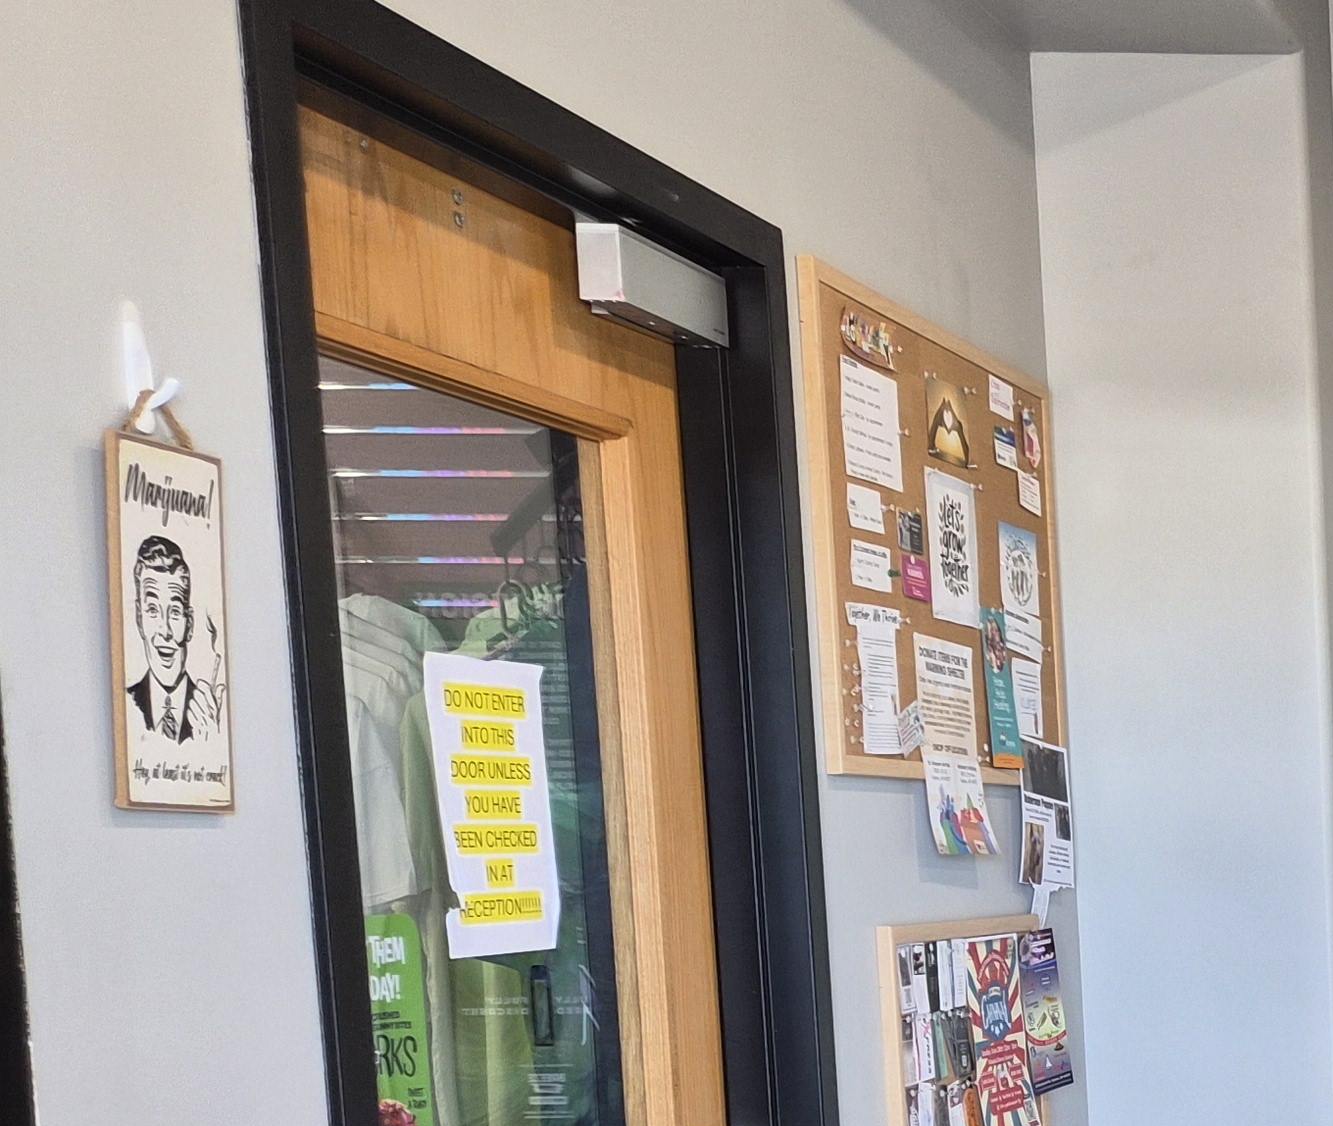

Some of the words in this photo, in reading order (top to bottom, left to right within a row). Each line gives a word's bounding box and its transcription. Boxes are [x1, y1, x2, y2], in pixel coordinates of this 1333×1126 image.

[124, 463, 214, 530] Marijuana!
[444, 689, 461, 707] DO
[464, 691, 490, 709] NOT
[491, 693, 525, 713] ENTER
[461, 726, 488, 744] INTO
[490, 727, 514, 746] THIS
[451, 760, 486, 778] DOOR
[488, 762, 531, 780] UNLESS
[464, 796, 490, 813] YOU
[491, 796, 522, 813] HAVE
[454, 830, 483, 848] BEEN
[485, 830, 537, 848] CHECKED
[486, 865, 498, 882] IN
[500, 864, 513, 881] AT
[368, 935, 406, 968] THEM
